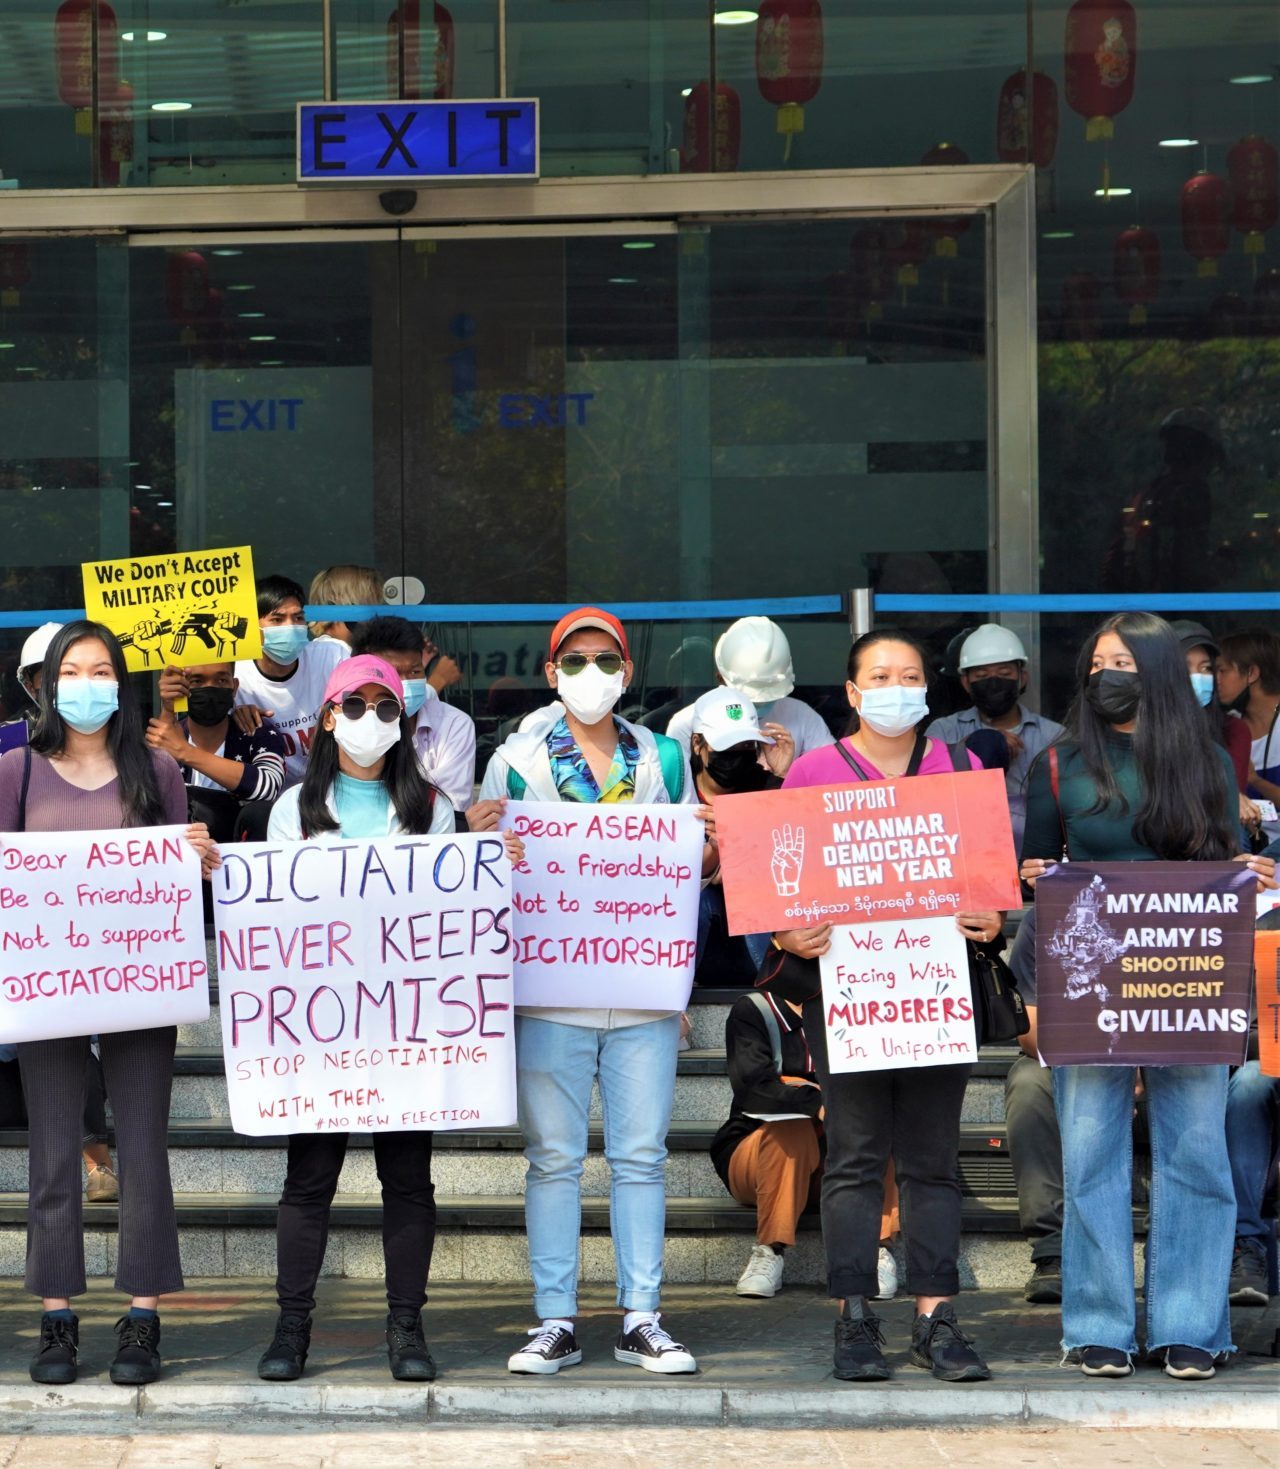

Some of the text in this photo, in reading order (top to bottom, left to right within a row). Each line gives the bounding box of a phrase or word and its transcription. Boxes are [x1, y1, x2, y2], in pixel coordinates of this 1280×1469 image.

[313, 109, 522, 171] EXIT
[211, 399, 304, 431] EXIT
[499, 392, 594, 427] EXIT
[94, 552, 241, 584] We Don't Accept
[101, 575, 239, 609] MILITARY COUP
[275, 713, 318, 729] support
[823, 786, 896, 813] SUPPORT
[514, 815, 676, 843] Dear ASEAN
[833, 813, 944, 842] MYANMAR
[3, 838, 183, 871] Dear ASEAN
[823, 834, 959, 866] DEMOCRACY
[217, 839, 506, 905] DICTATOR
[512, 859, 532, 874] e
[547, 861, 565, 874] a
[836, 858, 952, 888] NEW YEAR
[0, 887, 29, 909] Be
[44, 891, 64, 906] a
[77, 878, 192, 915] Friendship
[557, 890, 579, 912] to
[593, 893, 676, 925] support
[1106, 893, 1238, 914] MYANMAR
[3, 915, 185, 954] Not to support
[220, 907, 512, 971] NEVER KEEPS
[849, 929, 931, 951] We Are
[1124, 928, 1223, 947] ARMY IS
[836, 962, 956, 988] Facing With
[1121, 955, 1225, 973] SHOOTING
[2, 960, 207, 1002] DICTATORSHIP
[1122, 982, 1224, 998] INNOCENT
[230, 974, 510, 1048] PROMISE
[827, 997, 973, 1026] MURDERERS
[1097, 1008, 1248, 1033] CIVILIANS
[236, 1046, 488, 1080] STOP NEGOTIATING
[846, 1037, 970, 1060] In Uniform
[258, 1088, 385, 1119] WITH THEM.
[314, 1109, 480, 1130] #NO NEW ELECTION
